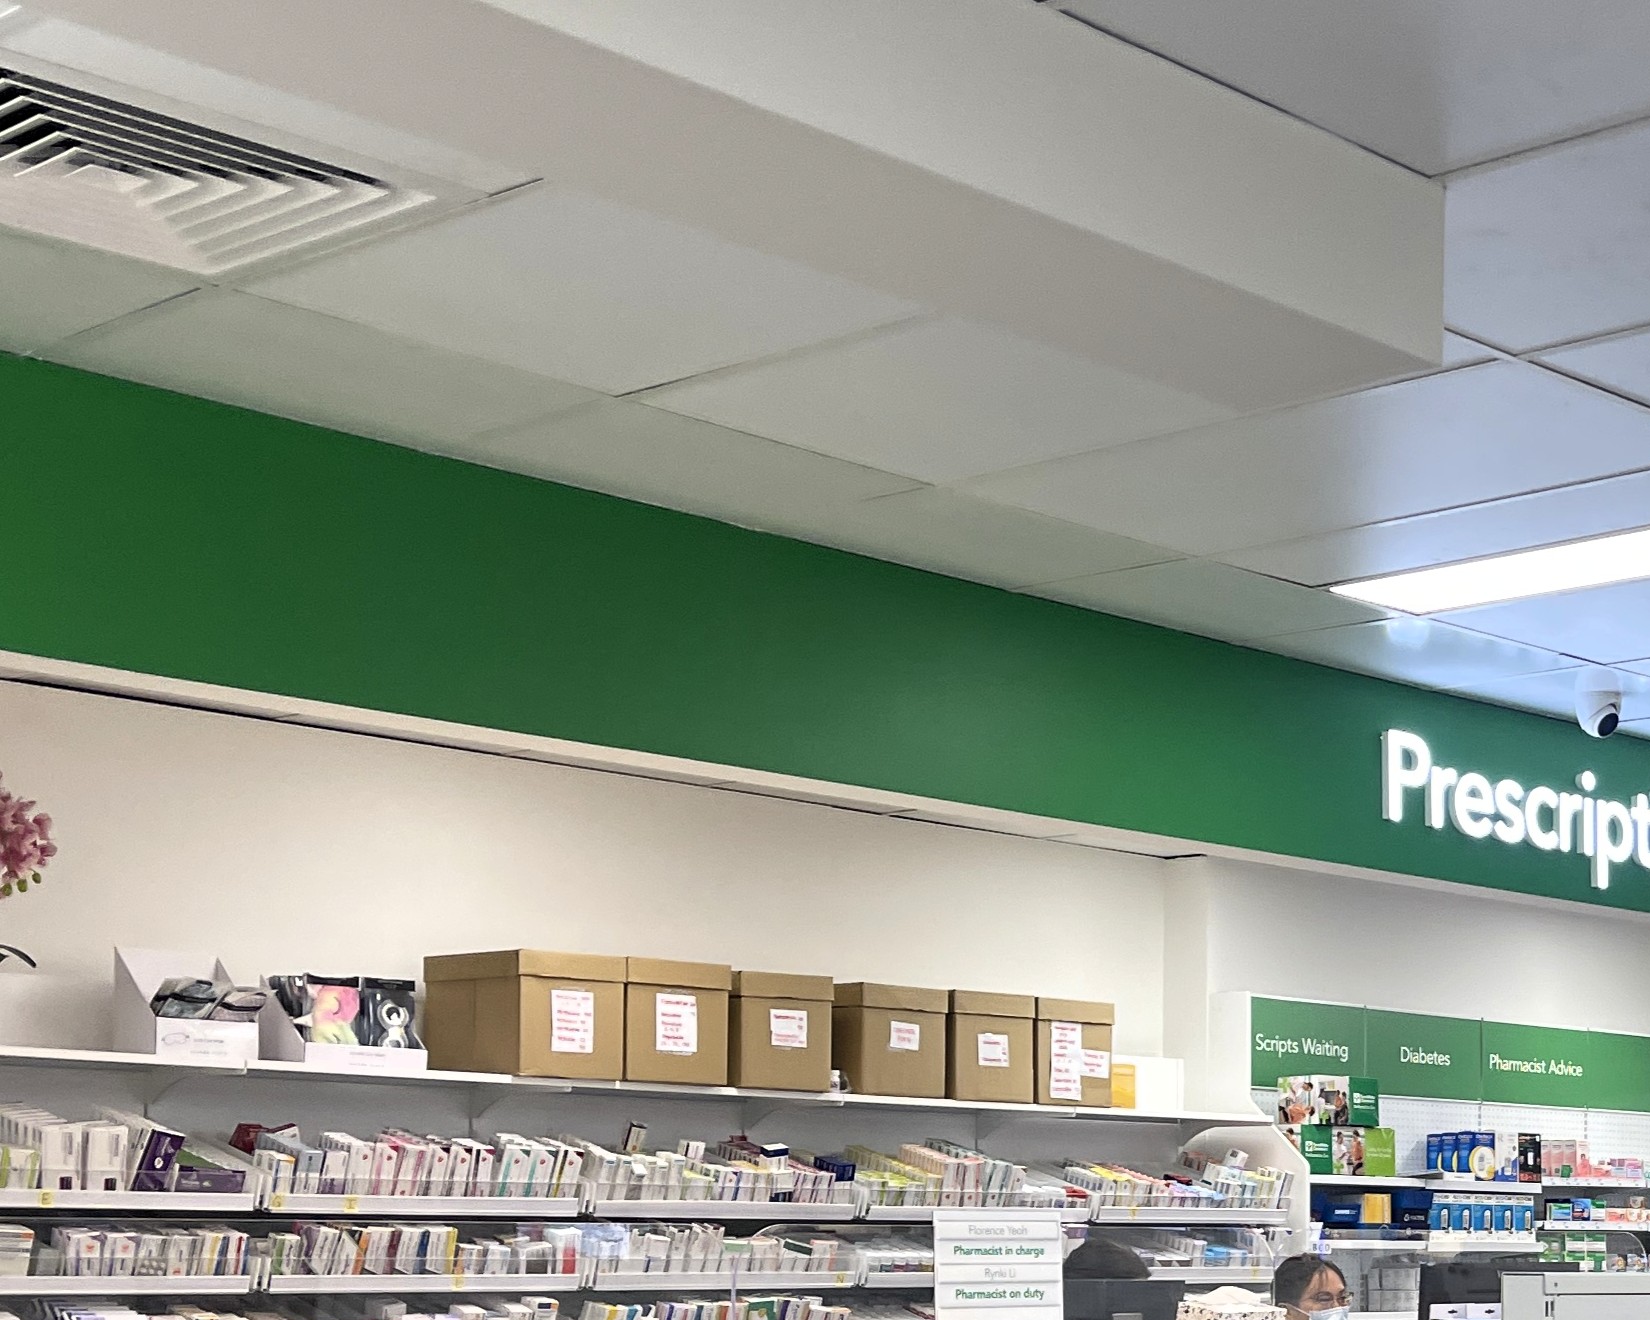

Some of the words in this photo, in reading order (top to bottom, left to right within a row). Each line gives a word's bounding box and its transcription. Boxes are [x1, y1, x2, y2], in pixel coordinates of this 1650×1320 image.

[1255, 1033, 1299, 1057] Scripts
[1302, 1037, 1349, 1063] Waiting
[1400, 1046, 1450, 1067] Diabetes
[1488, 1054, 1547, 1076] Pharmacist
[1550, 1058, 1583, 1078] Advice
[953, 1246, 1002, 1256] Pharmacist
[1005, 1246, 1013, 1255] in
[1015, 1246, 1044, 1258] charge
[956, 1289, 1007, 1299] Pharmacist
[1010, 1290, 1021, 1299] on
[1024, 1288, 1044, 1300] duty
